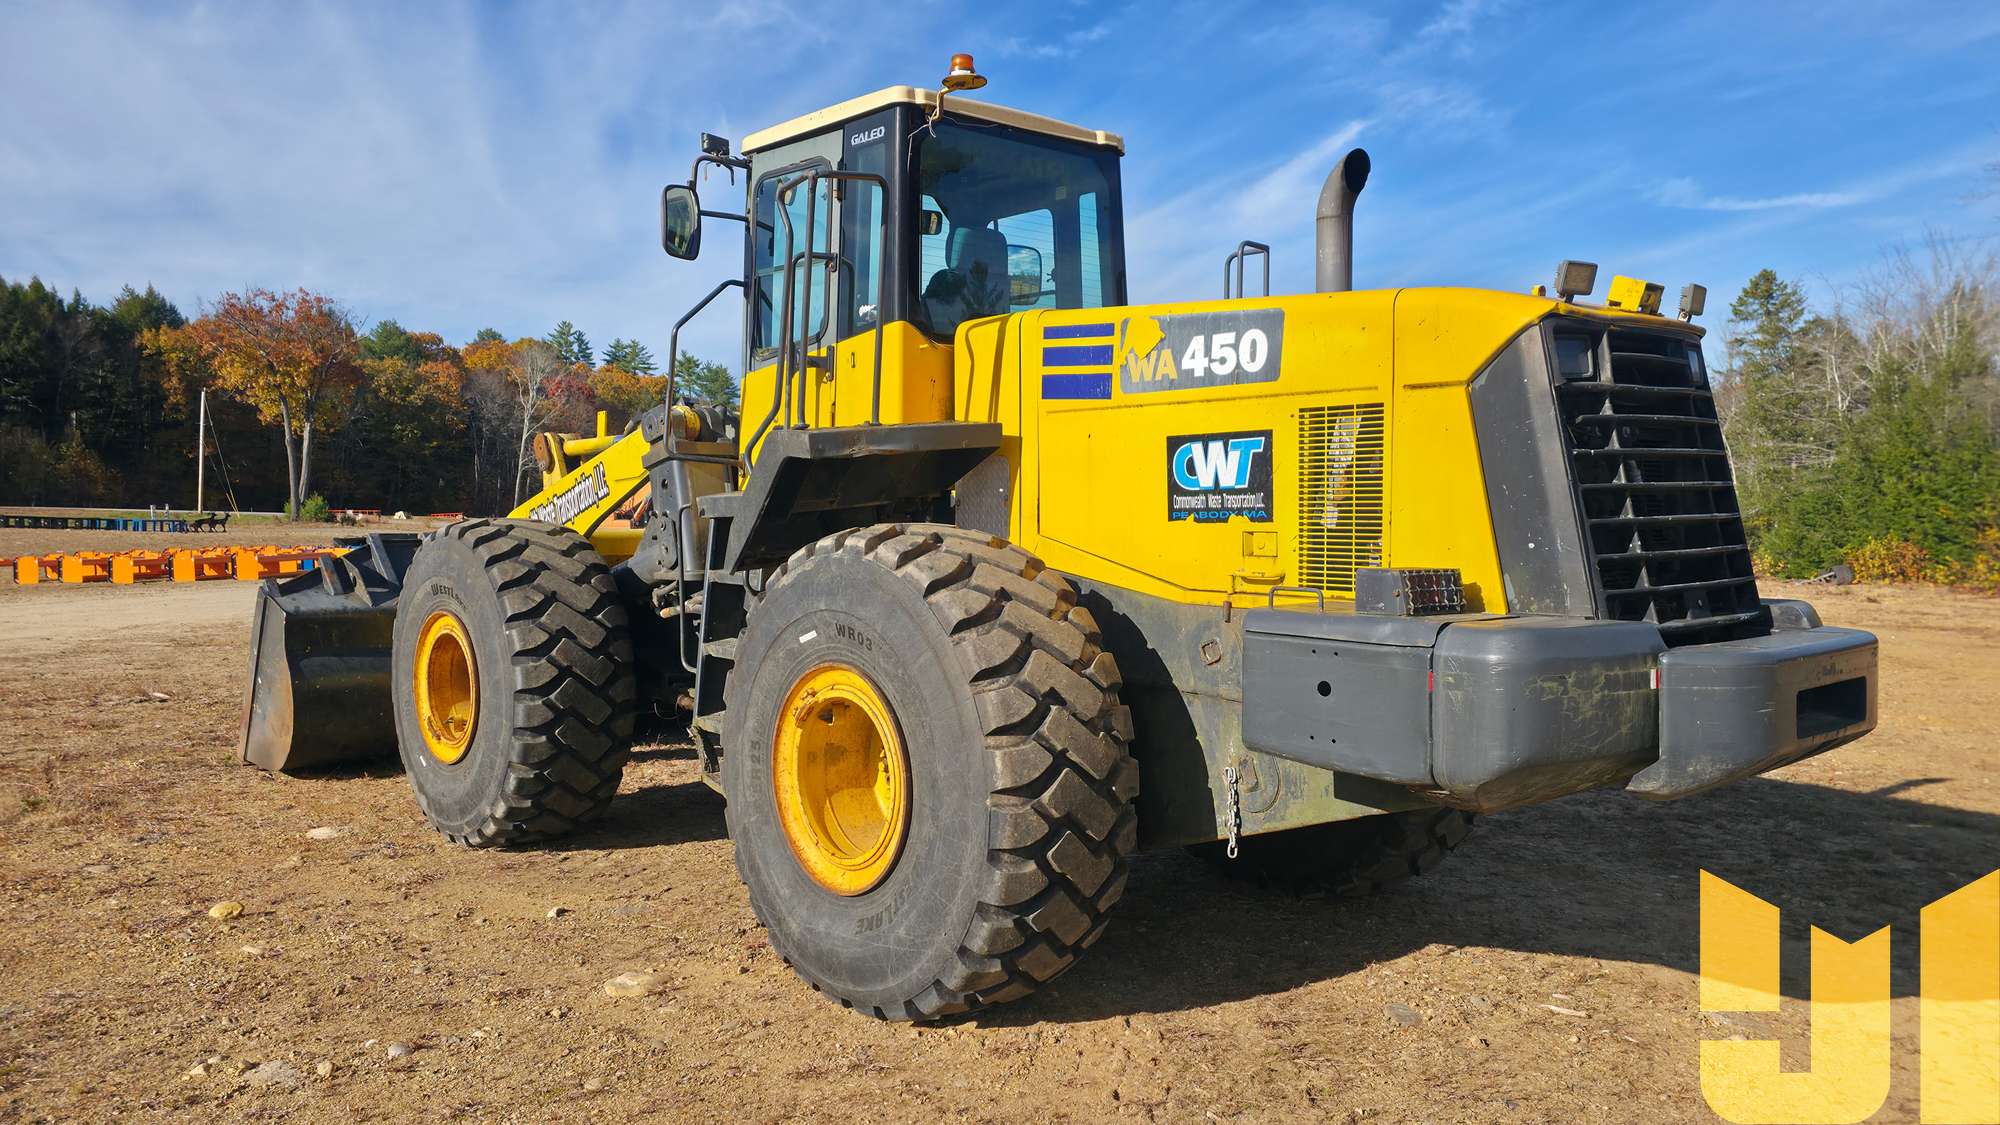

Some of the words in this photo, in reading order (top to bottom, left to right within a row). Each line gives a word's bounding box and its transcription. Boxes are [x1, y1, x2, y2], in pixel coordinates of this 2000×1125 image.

[851, 126, 885, 146] GALEO
[1127, 348, 1178, 384] WA
[1181, 328, 1269, 378] 450
[1172, 436, 1266, 491] CWT
[1207, 493, 1222, 509] Waste
[835, 622, 873, 652] WR03
